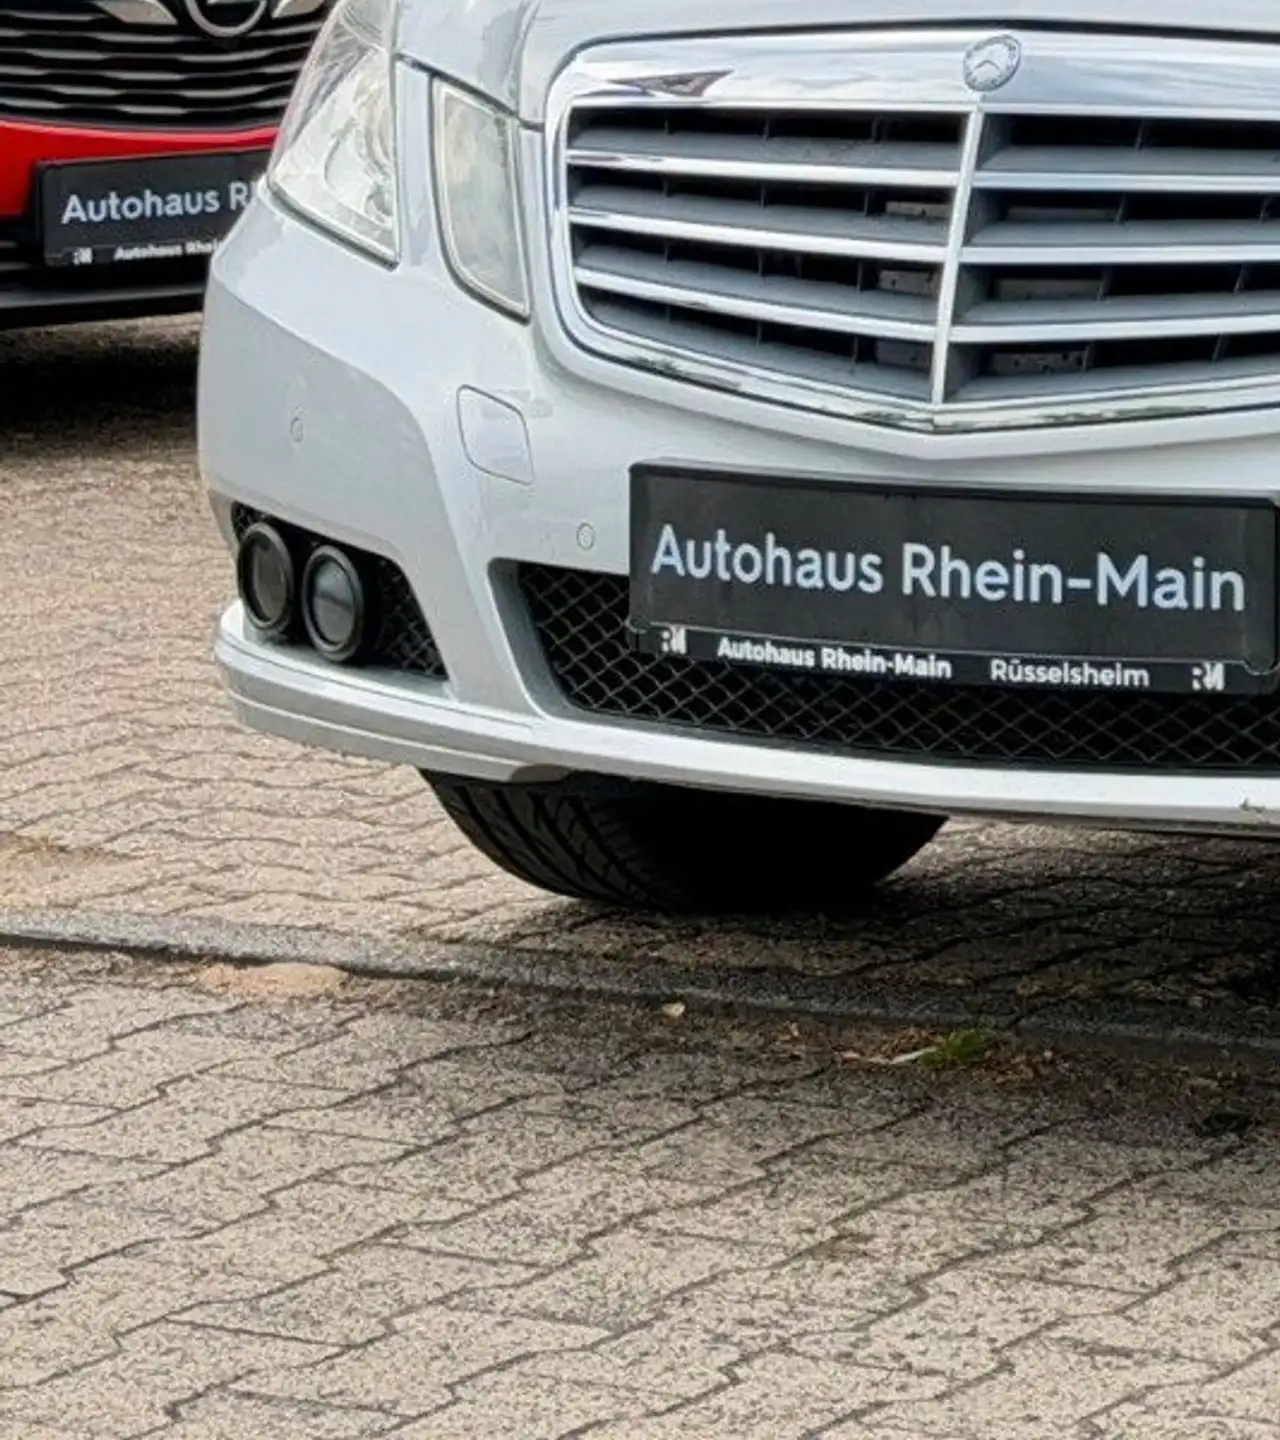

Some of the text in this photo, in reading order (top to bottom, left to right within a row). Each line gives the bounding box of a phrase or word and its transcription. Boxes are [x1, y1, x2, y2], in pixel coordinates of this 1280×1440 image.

[61, 189, 220, 224] Autohaus
[650, 523, 1245, 611] Autohaus Rhein-Main
[716, 635, 815, 667] Autohaus
[820, 646, 952, 679] Rhein-Main
[990, 659, 1150, 688] Rüsselsheim
